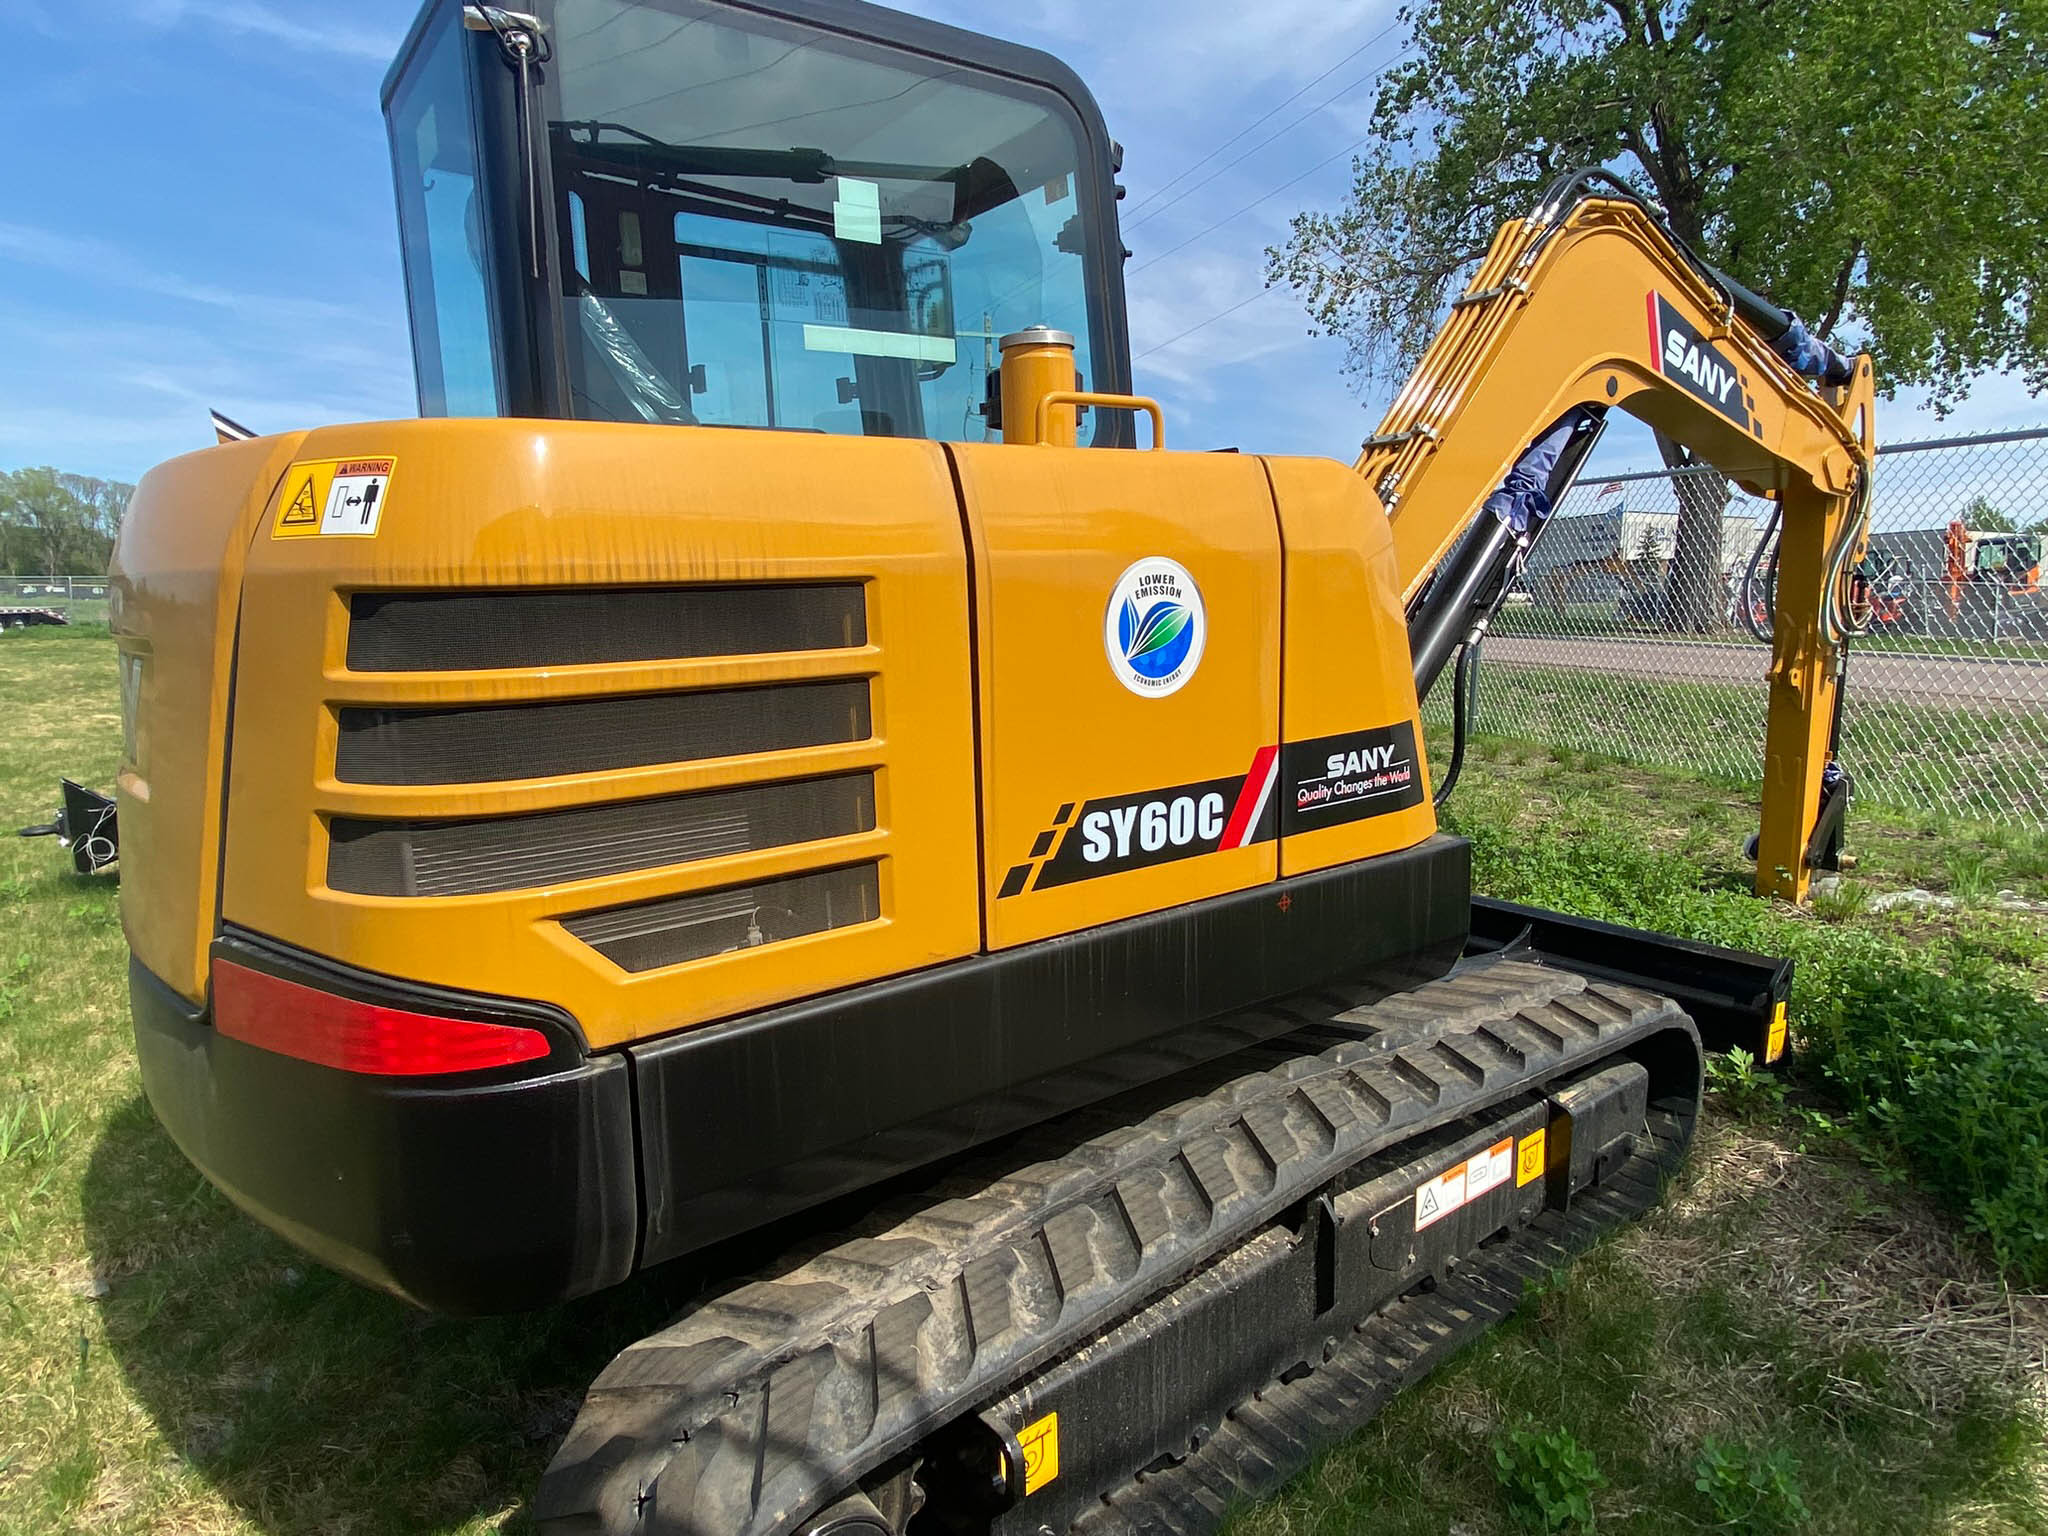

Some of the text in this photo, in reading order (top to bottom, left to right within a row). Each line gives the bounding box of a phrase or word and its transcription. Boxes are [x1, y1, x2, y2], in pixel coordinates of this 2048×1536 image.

[1664, 328, 1736, 404] SANY
[349, 462, 389, 473] WARNING
[1135, 585, 1182, 600] EMISSION
[1138, 574, 1175, 587] LOWER
[1133, 668, 1182, 686] ECONOMIC ENERGY
[1327, 743, 1395, 779] SANY
[1297, 766, 1411, 802] Quality Changes the World
[1081, 792, 1224, 863] SY60C
